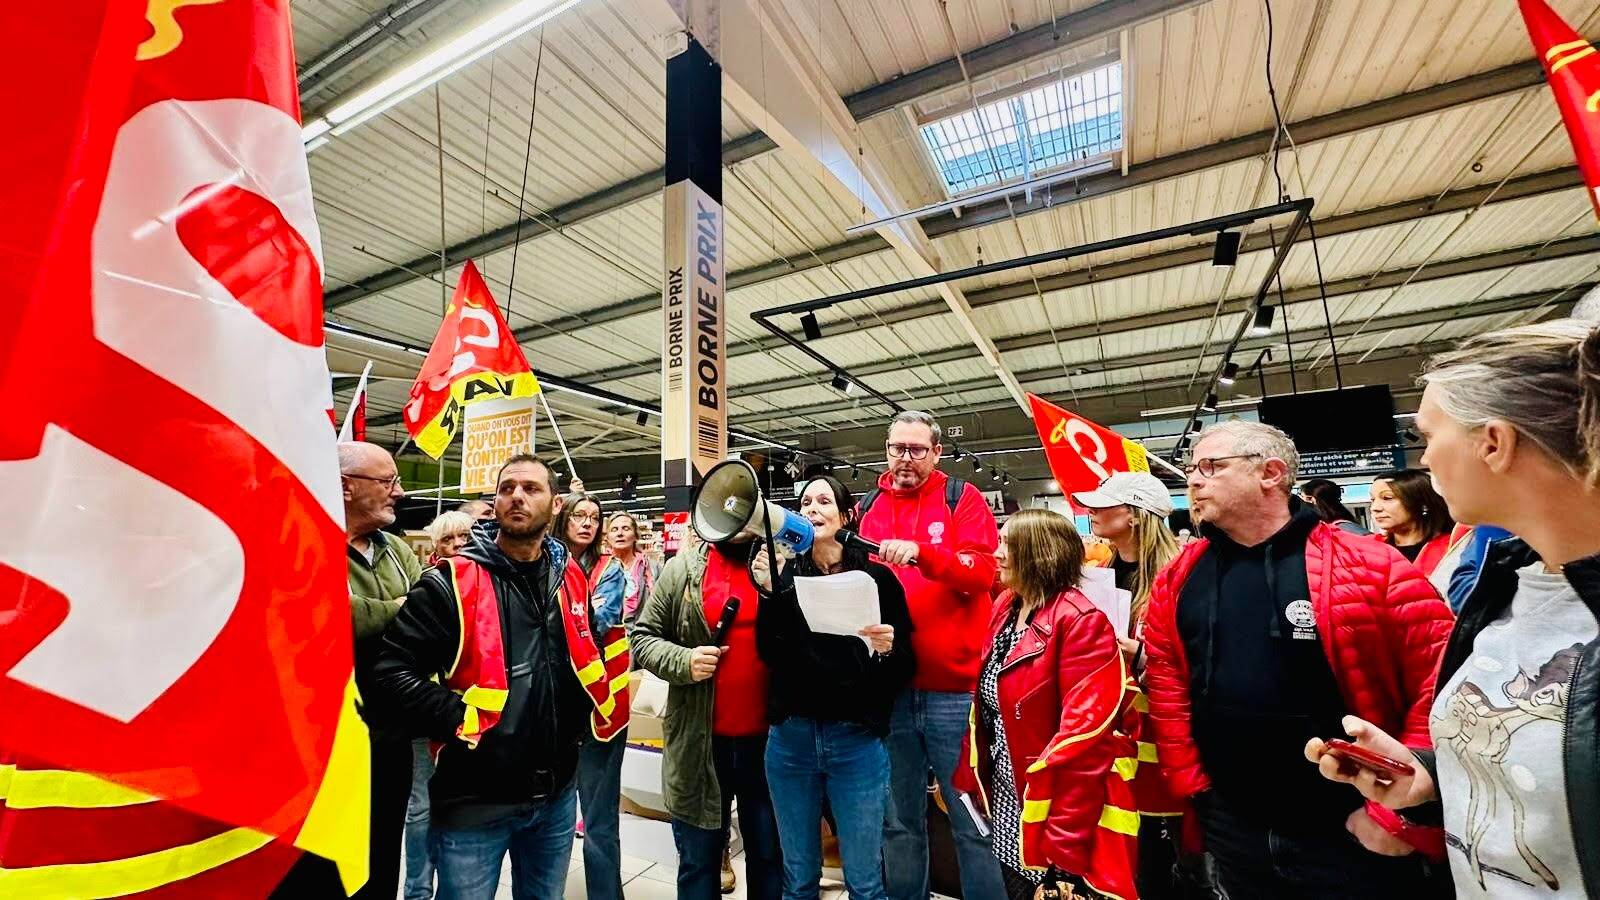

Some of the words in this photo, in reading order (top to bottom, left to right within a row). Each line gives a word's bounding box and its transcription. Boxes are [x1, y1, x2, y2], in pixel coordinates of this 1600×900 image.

[697, 199, 717, 285] PRIX
[669, 266, 683, 306] PRIX
[669, 312, 683, 368] BORNE
[697, 287, 719, 410] BORNE
[467, 422, 491, 433] QUAND
[503, 416, 520, 428] VOUS
[521, 413, 532, 424] DIT
[510, 425, 531, 444] EST
[465, 447, 513, 468] CONTRE
[465, 467, 486, 488] VIE
